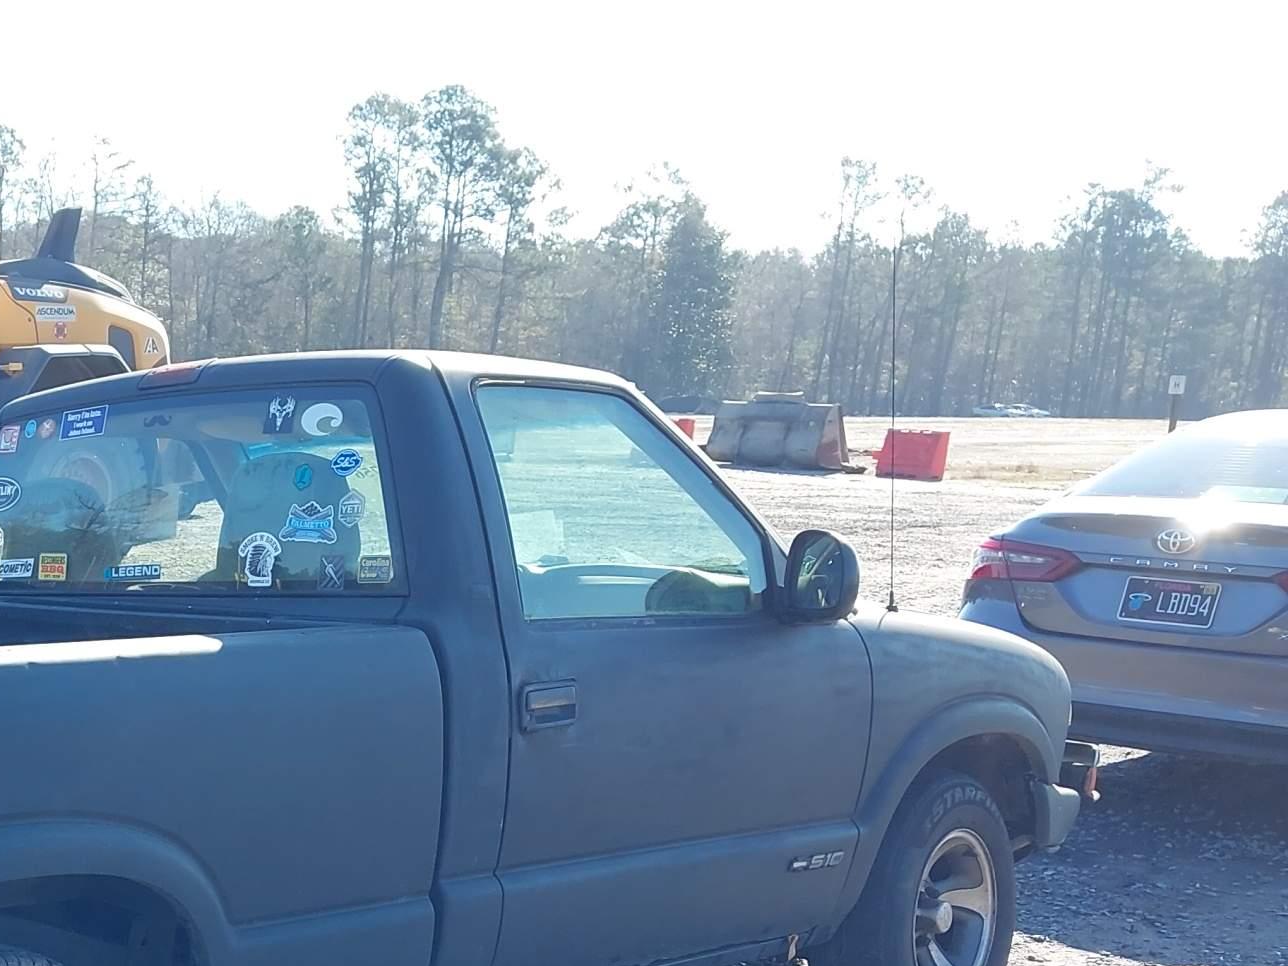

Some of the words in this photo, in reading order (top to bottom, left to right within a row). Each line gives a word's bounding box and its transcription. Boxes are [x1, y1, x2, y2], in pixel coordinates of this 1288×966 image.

[13, 287, 64, 298] VOLVO
[36, 307, 76, 316] ASCENDUM
[334, 456, 357, 467] S&S
[342, 505, 361, 514] YETI
[291, 519, 329, 528] PALMETTO
[41, 565, 64, 574] BBQ
[1110, 557, 1237, 572] CAMRY
[112, 566, 160, 577] LEGEND
